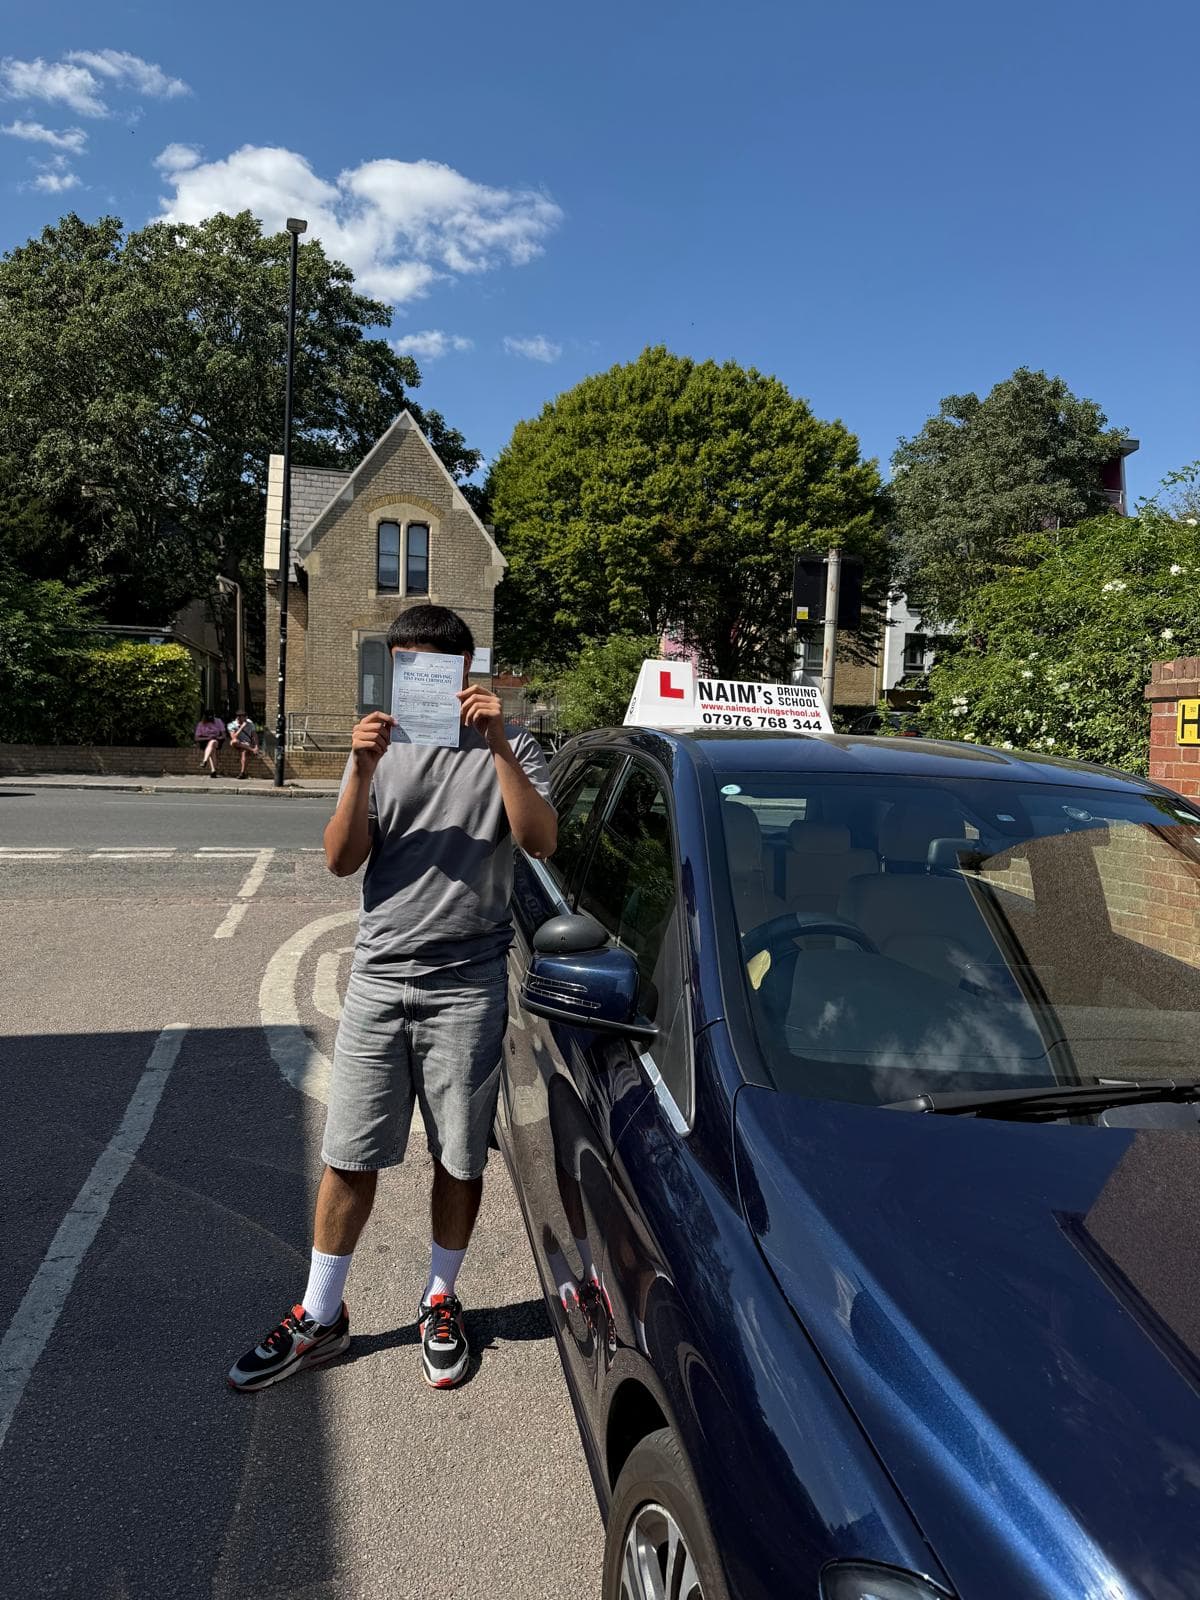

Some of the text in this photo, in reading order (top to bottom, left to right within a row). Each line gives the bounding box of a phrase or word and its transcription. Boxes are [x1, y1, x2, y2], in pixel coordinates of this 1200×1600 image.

[660, 671, 684, 699] L
[698, 681, 773, 705] NAIM's
[777, 686, 817, 698] DRIVING
[701, 703, 821, 718] www.naimsdrivingschool.uk
[778, 697, 819, 708] SCHOOL
[702, 712, 823, 731] 07976 768 344
